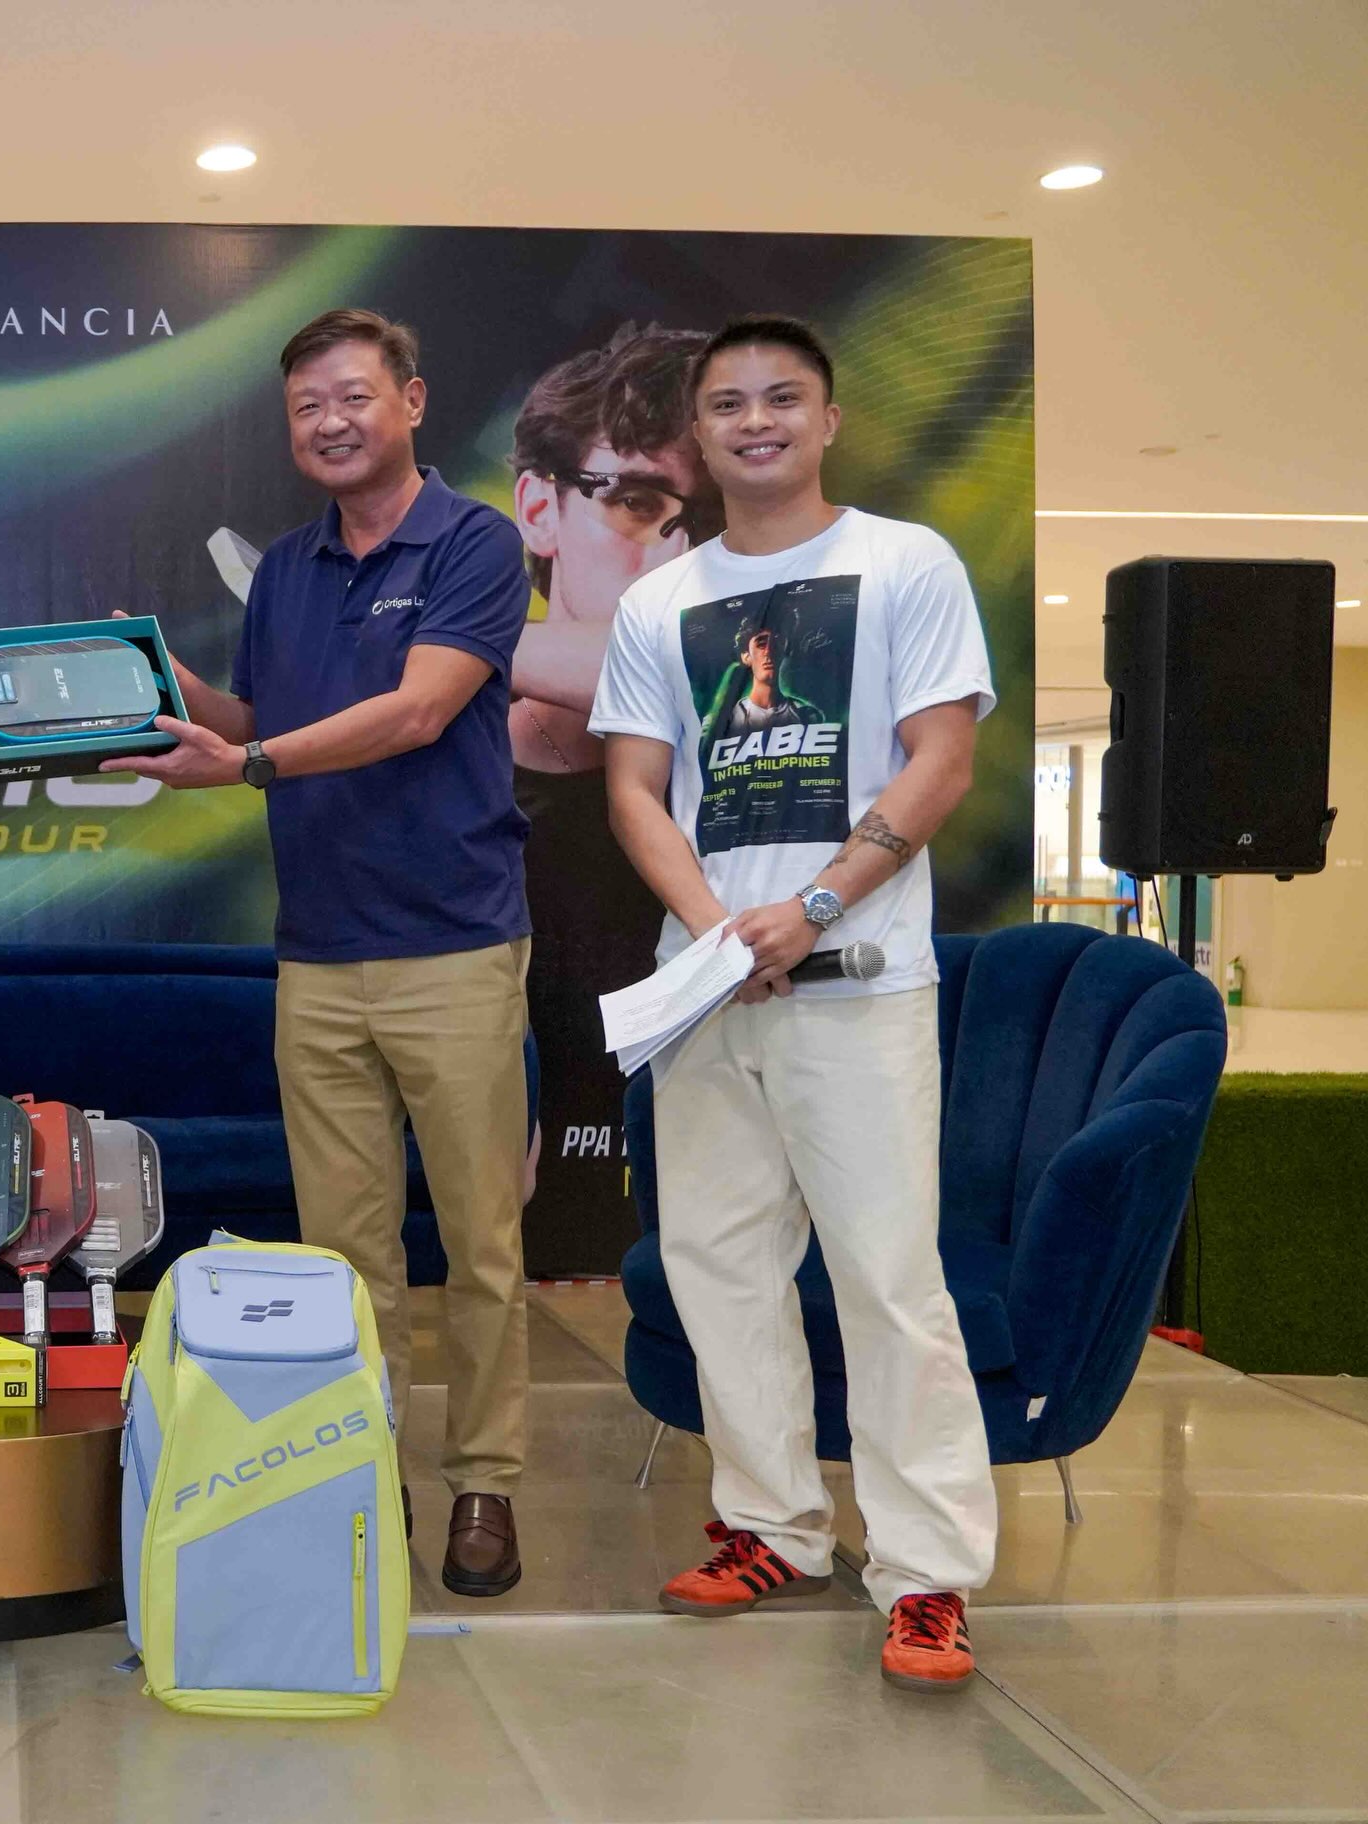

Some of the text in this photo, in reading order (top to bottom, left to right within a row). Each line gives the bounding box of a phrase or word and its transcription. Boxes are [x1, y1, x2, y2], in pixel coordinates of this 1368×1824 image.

[384, 597, 412, 609] Ortigas
[707, 722, 842, 771] GABE
[713, 770, 727, 782] IN
[561, 1126, 611, 1157] PPA
[174, 1410, 370, 1513] FACOLOS
